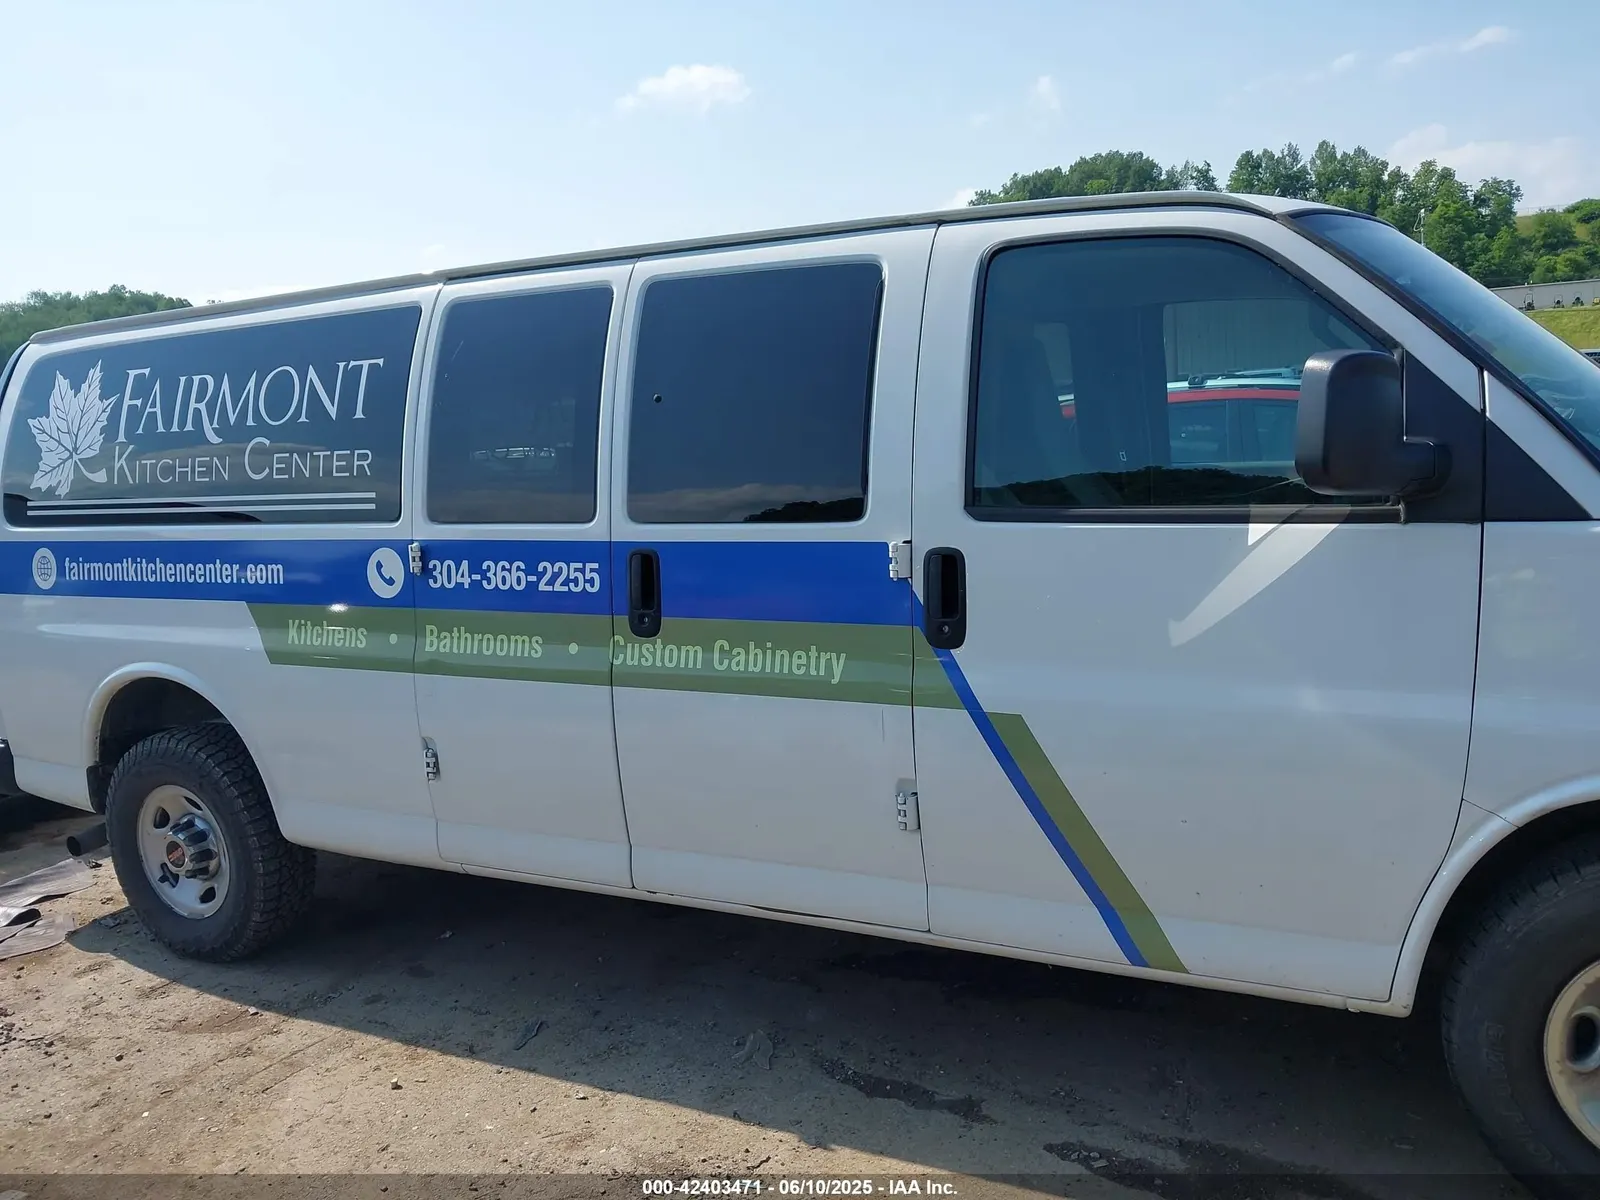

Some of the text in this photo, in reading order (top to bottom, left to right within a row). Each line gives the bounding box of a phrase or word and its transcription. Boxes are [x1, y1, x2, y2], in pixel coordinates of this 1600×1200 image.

[116, 358, 384, 444] FAIRMONT
[113, 436, 372, 485] KITCHEN CENTER
[64, 557, 284, 585] fairmontkitchencenter.com
[428, 559, 600, 593] 304-366-2255
[287, 619, 847, 685] Kitchens Bathrooms Custom Cabinetry
